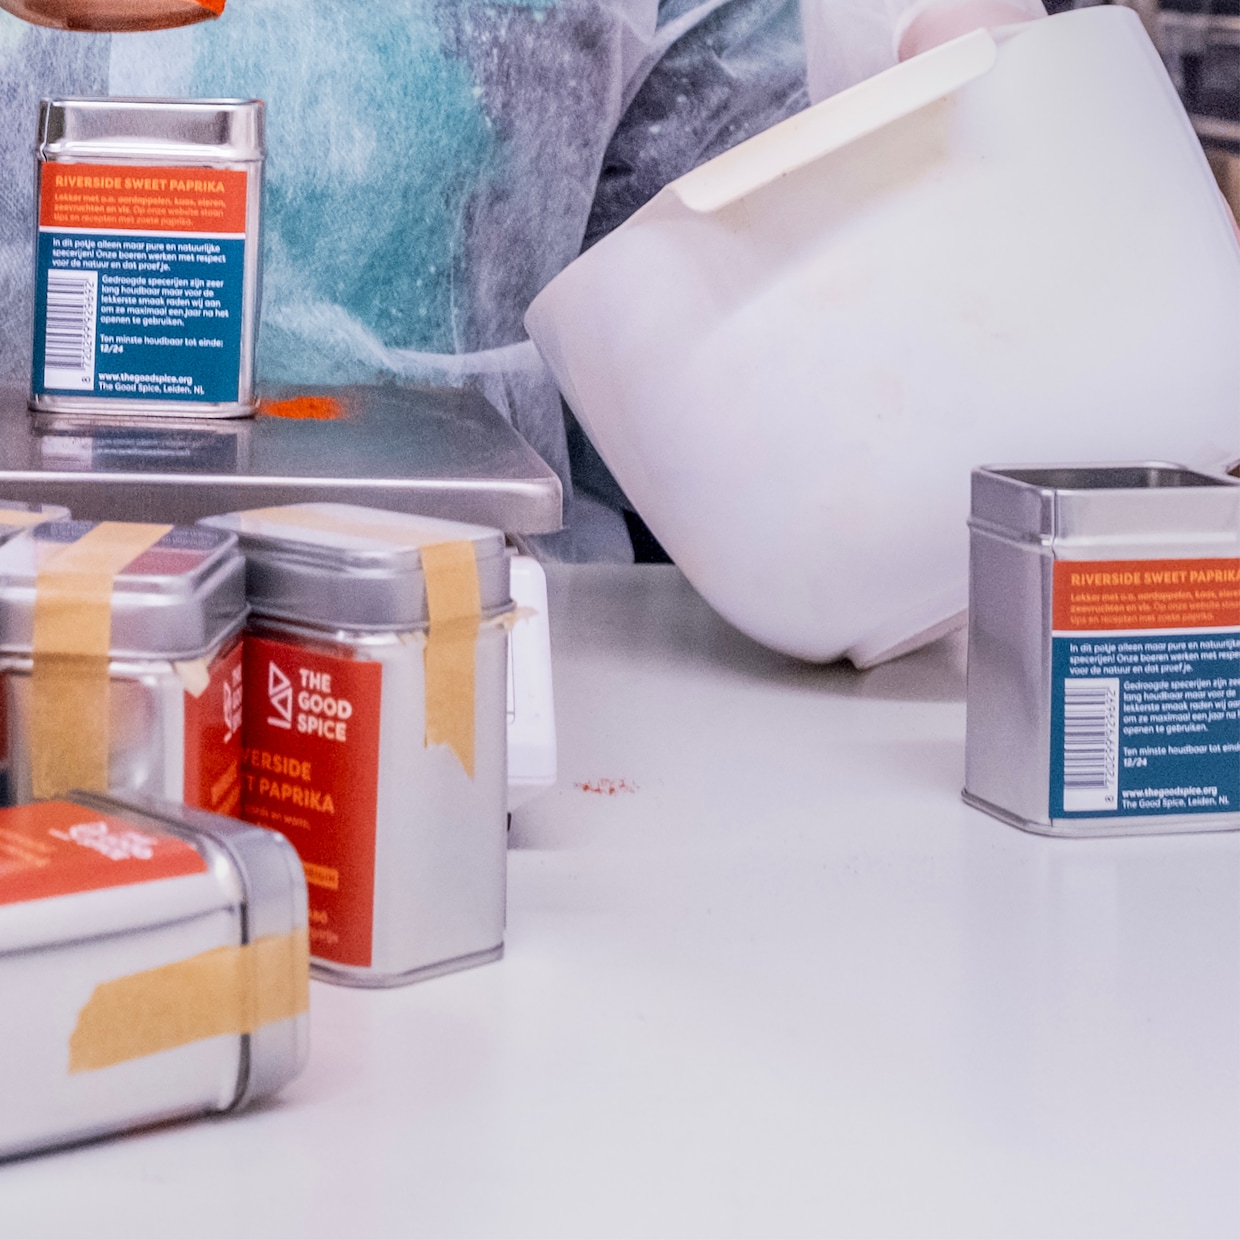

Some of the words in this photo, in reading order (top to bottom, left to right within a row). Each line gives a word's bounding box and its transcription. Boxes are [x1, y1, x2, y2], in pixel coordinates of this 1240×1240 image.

[56, 176, 121, 188] RIVERSIDE
[125, 178, 166, 190] SWEET
[170, 180, 225, 192] PAPRIKA
[53, 238, 60, 246] In
[62, 239, 73, 247] dit
[74, 239, 96, 249] potje
[97, 240, 122, 249] alleen
[146, 243, 164, 252] pure
[178, 243, 220, 254] natuurlijke
[96, 250, 117, 259] Onze
[118, 251, 147, 260] boeren
[148, 252, 177, 261] werken
[178, 253, 195, 261] met
[196, 254, 226, 264] respect
[70, 259, 81, 267] de
[82, 259, 109, 268] natuur
[122, 261, 137, 269] dat
[138, 261, 160, 271] proef
[102, 275, 146, 286] Gedroogde
[148, 277, 188, 288] specerijen
[190, 278, 204, 288] zijn
[102, 285, 120, 295] lang
[121, 286, 160, 295] houdbaar
[203, 289, 214, 297] de
[101, 295, 137, 304] lekkerste
[138, 296, 164, 305] smaak
[166, 298, 190, 306] raden
[191, 298, 203, 308] wij
[127, 306, 167, 315] maximaal
[184, 308, 201, 318] jaar
[215, 309, 229, 318] het
[100, 316, 131, 325] openen
[132, 316, 141, 324] te
[100, 334, 114, 343] Ten
[116, 335, 143, 344] minste
[144, 336, 183, 346] houdbaar
[184, 338, 197, 346] tot
[99, 382, 114, 390] The
[115, 382, 136, 391] Good
[194, 385, 204, 394] NL
[1071, 573, 1140, 586] RIVERSIDE
[1144, 571, 1187, 583] SWEET
[1218, 651, 1240, 660] respe
[300, 668, 332, 693] THE
[298, 690, 352, 720] GOOD
[297, 715, 347, 742] SPICE
[1222, 743, 1240, 752] eind
[260, 778, 334, 814] PAPRIKA
